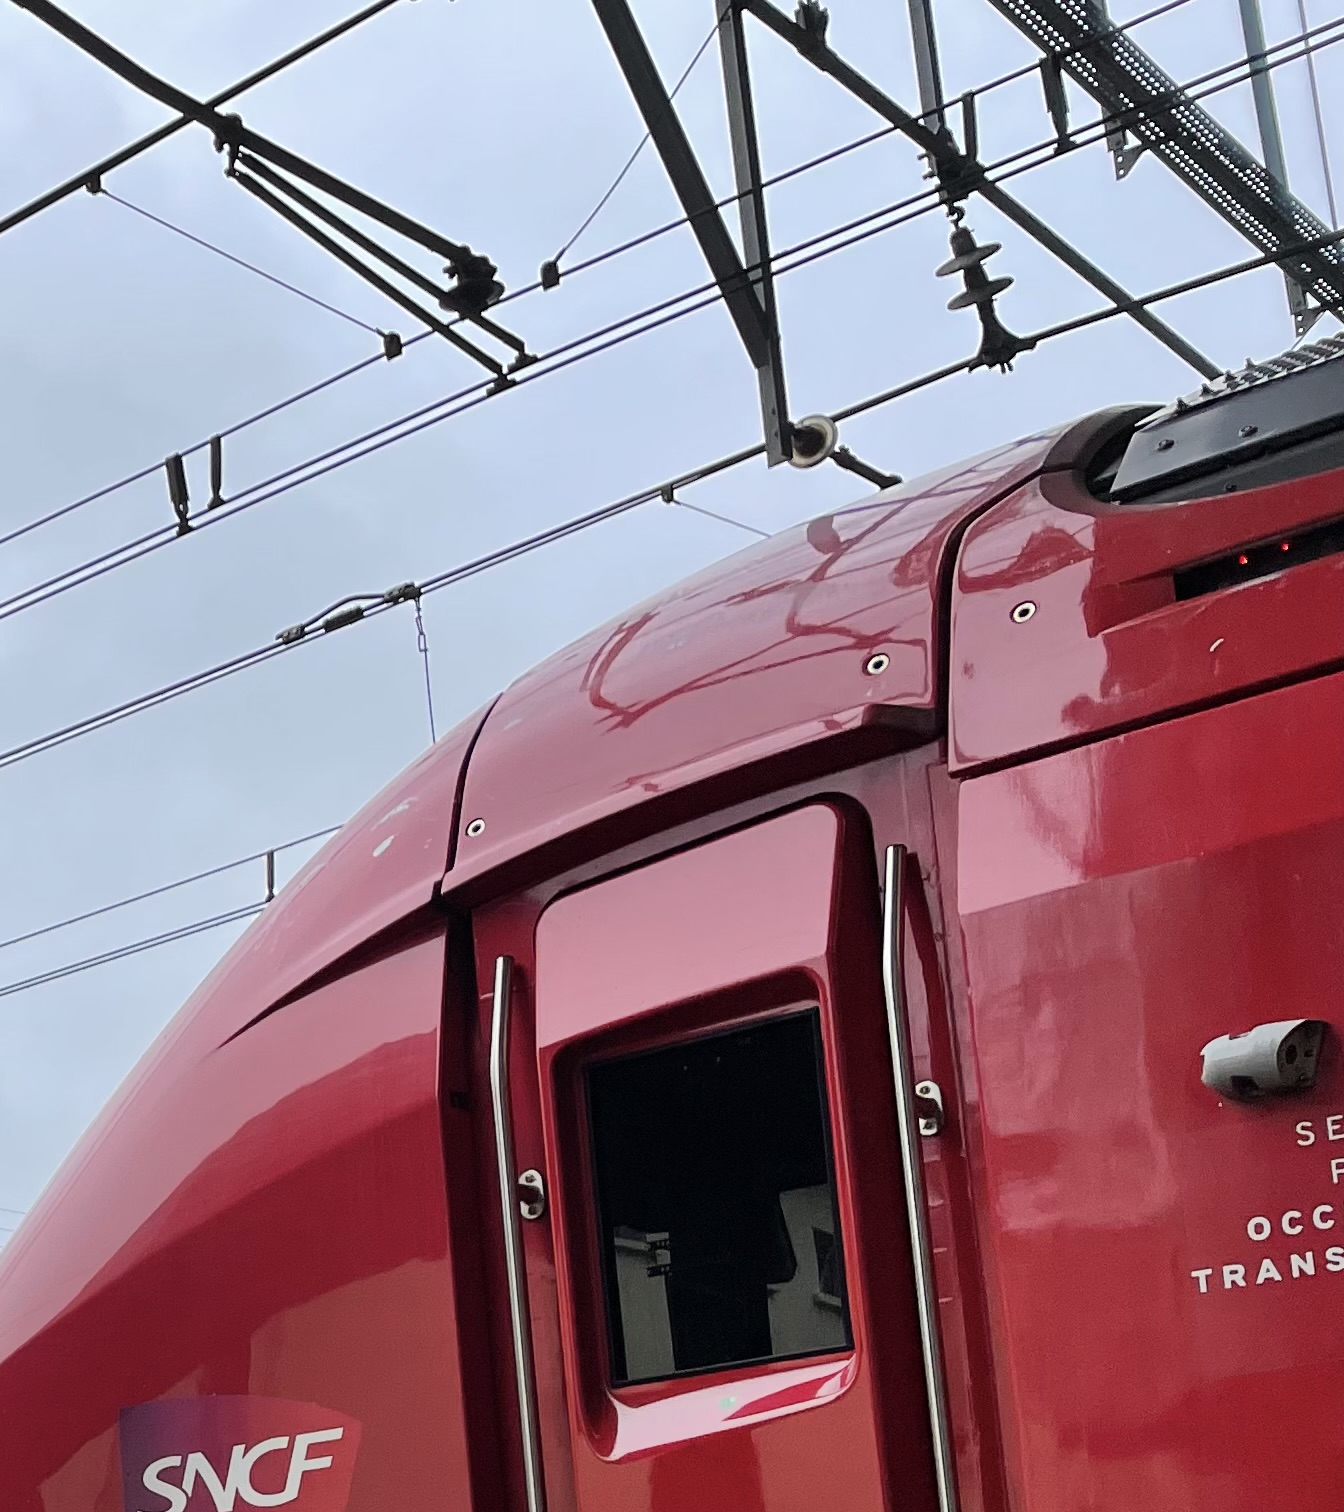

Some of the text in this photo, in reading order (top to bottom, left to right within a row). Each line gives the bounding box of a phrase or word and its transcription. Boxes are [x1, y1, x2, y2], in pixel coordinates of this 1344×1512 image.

[1295, 1114, 1344, 1146] SE
[1247, 1204, 1335, 1241] OCC
[1190, 1246, 1344, 1293] TRANS
